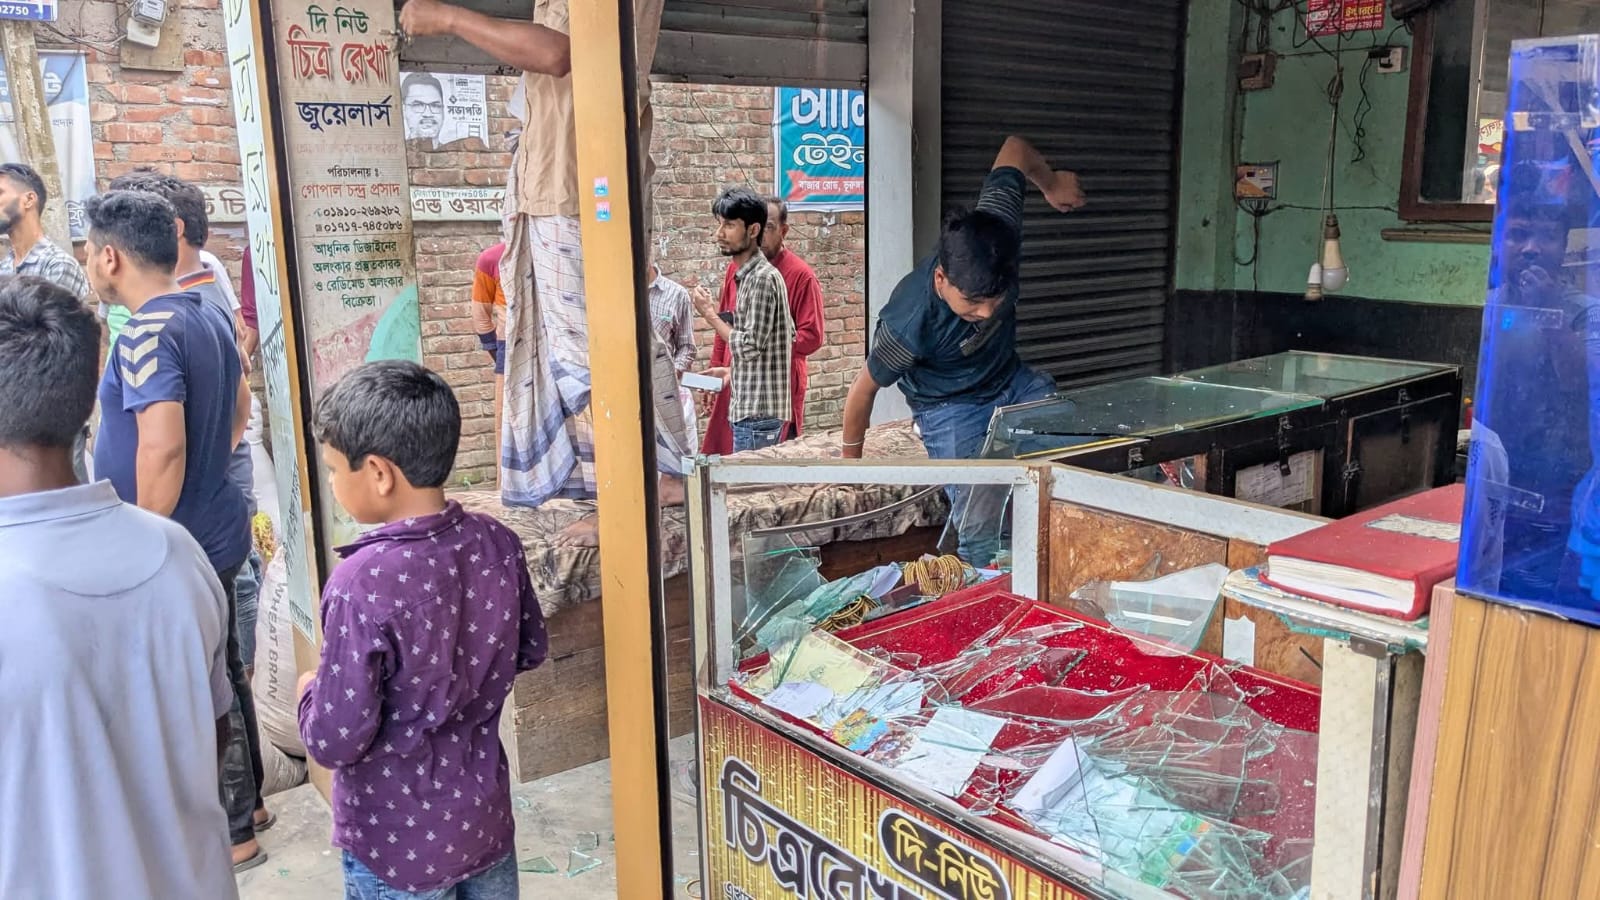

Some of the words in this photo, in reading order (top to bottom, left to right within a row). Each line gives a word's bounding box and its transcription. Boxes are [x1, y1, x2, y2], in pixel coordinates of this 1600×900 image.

[307, 6, 328, 33] দি
[333, 8, 369, 34] নিউ
[287, 24, 331, 82] চিত্র
[341, 40, 389, 83] রেখা
[295, 95, 393, 131] জুয়েলার্স
[447, 104, 482, 116] সভাপতি
[327, 165, 371, 178] পরিচালনায়
[302, 183, 342, 199] গোপাল
[346, 183, 367, 199] চন্দ্র
[370, 182, 401, 197] প্রসাদ
[323, 206, 402, 217] ০১৯১০-২৬৯২৮২
[449, 192, 505, 215] ওয়ার্ক
[324, 221, 403, 232] ০১৭১৭-৭৪৫০৮৬
[314, 240, 350, 257] আধুনিক
[353, 239, 397, 254] ডিজাইনের
[313, 261, 352, 273] অলংকার
[314, 281, 323, 292] ও
[326, 276, 366, 292] রেডিমেড
[368, 276, 404, 289] অলংকার
[267, 582, 288, 647] WHEAT
[266, 650, 279, 700] BRAN
[719, 755, 924, 900] চিত্ররে
[890, 817, 1000, 900] দি-নিউ
